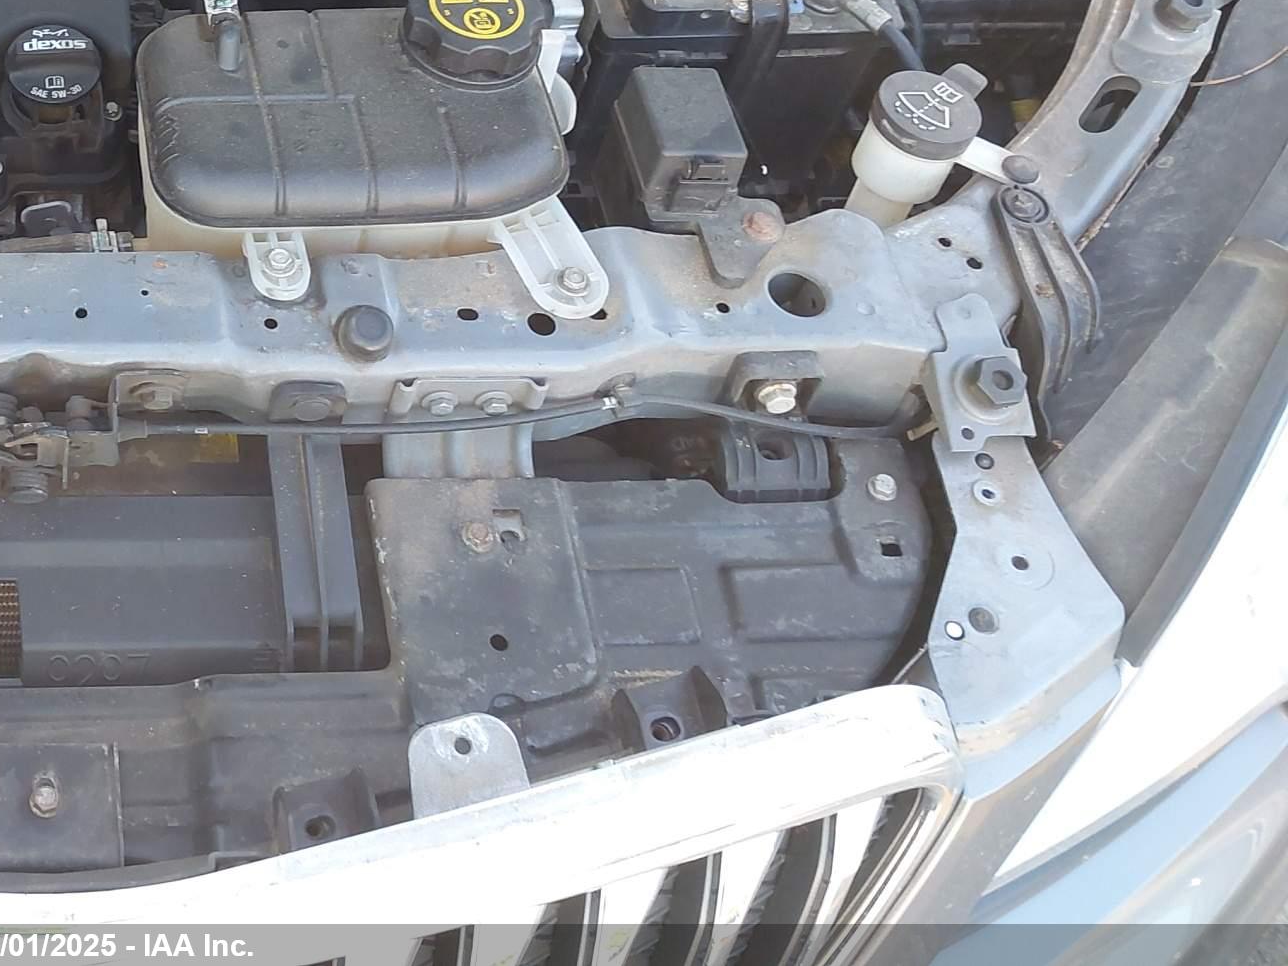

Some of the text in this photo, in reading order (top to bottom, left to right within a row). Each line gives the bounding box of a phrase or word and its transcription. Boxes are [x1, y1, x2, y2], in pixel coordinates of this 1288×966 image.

[23, 38, 89, 52] dexos
[30, 84, 82, 99] SAE 5W-30
